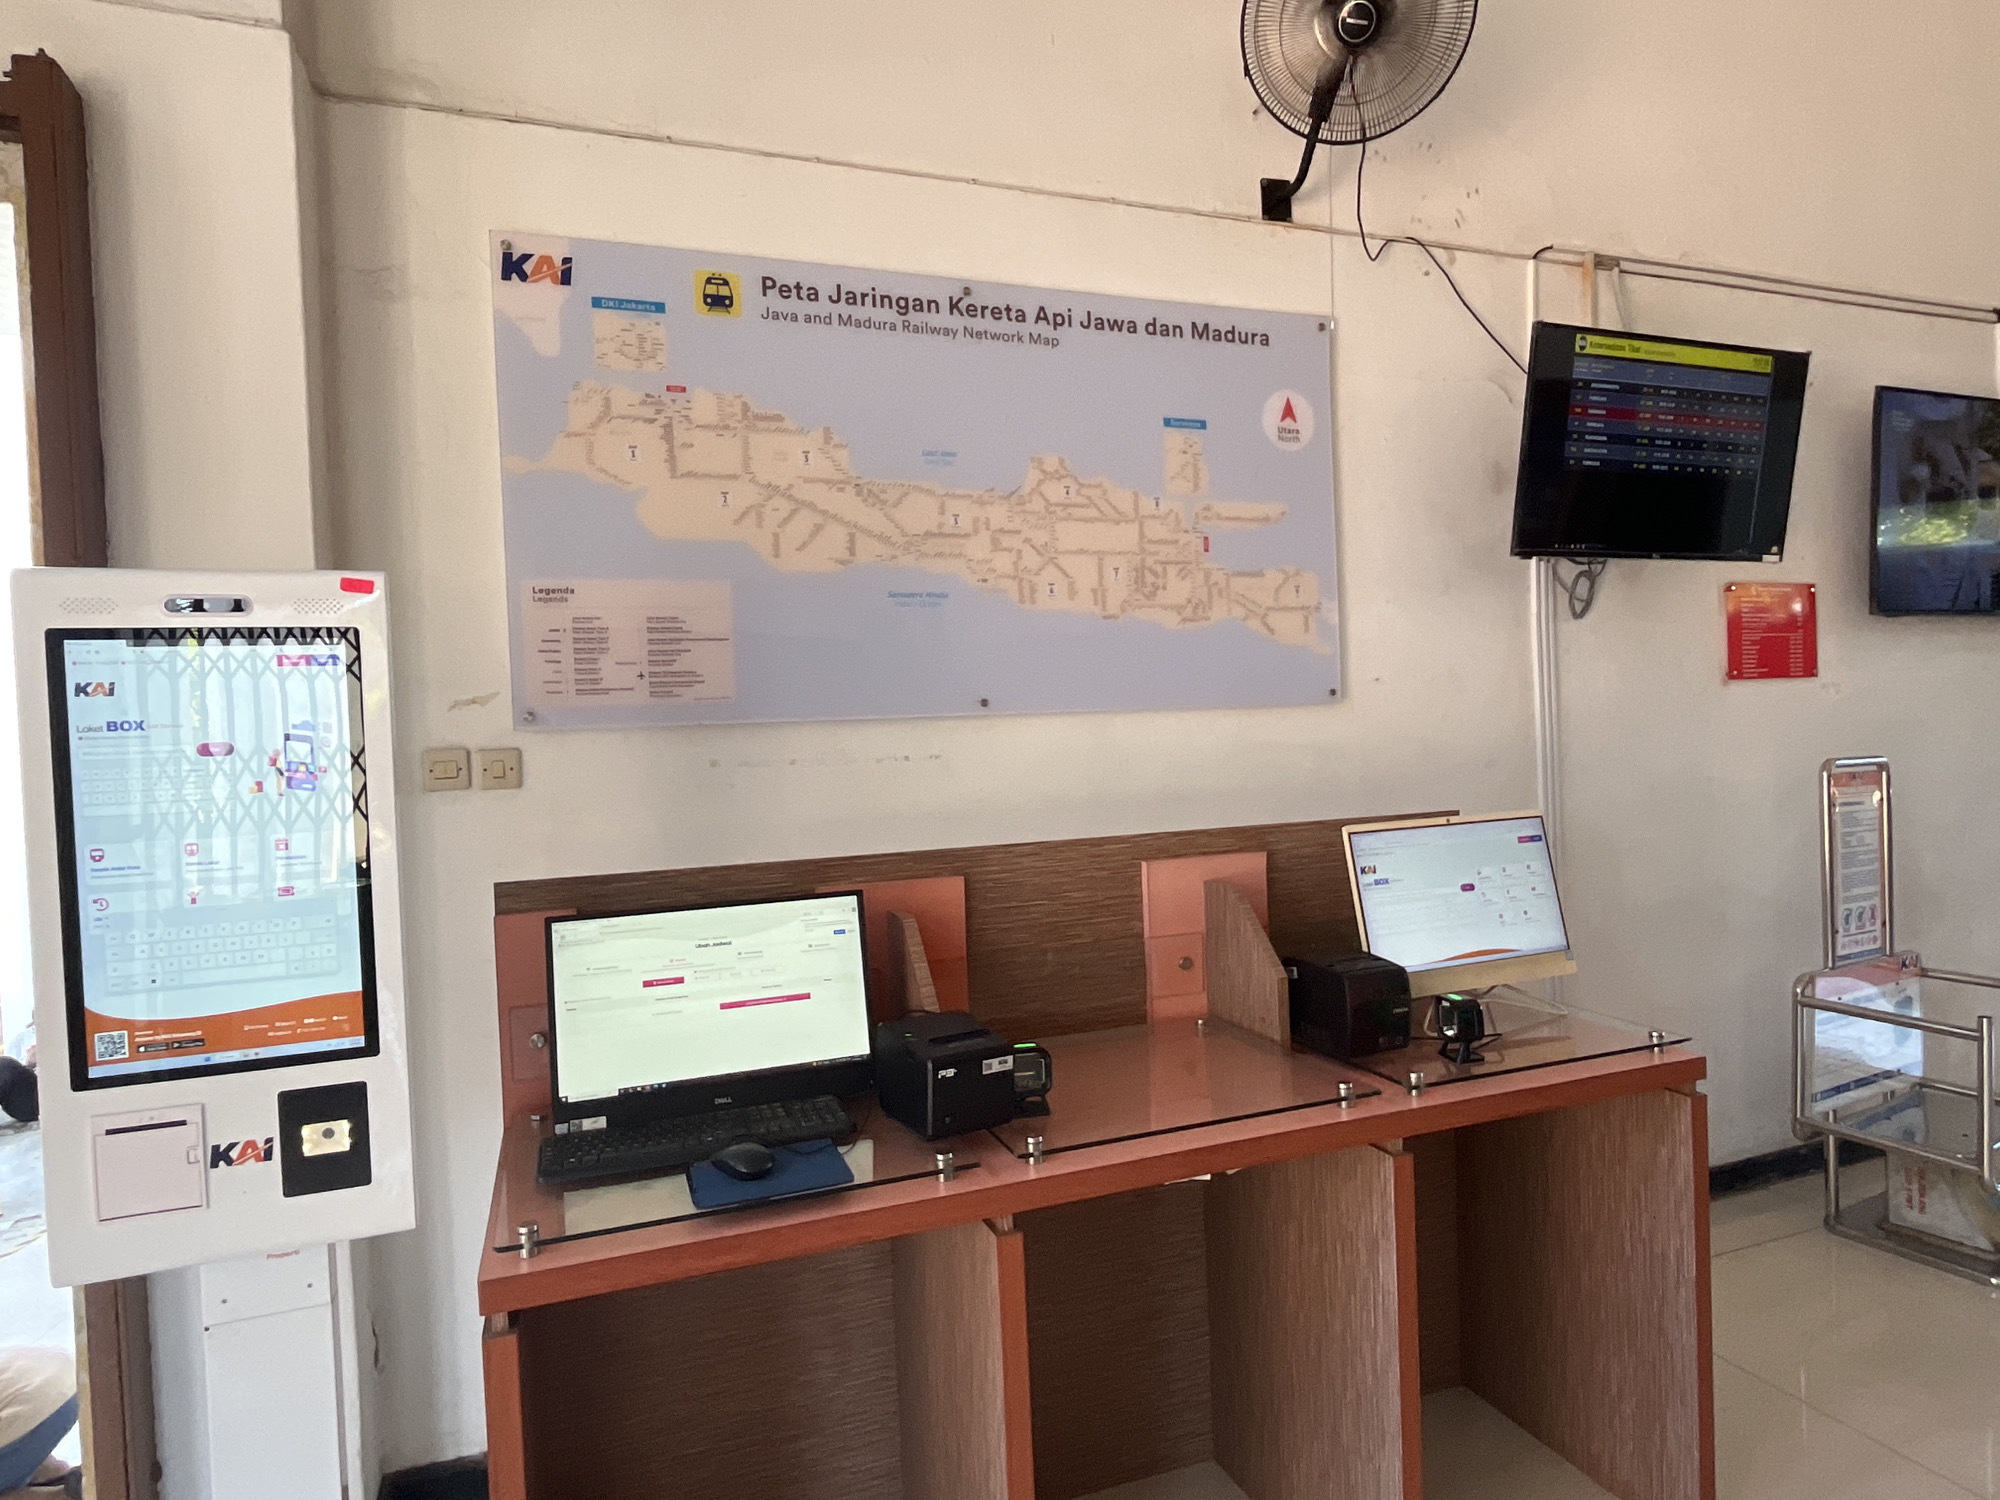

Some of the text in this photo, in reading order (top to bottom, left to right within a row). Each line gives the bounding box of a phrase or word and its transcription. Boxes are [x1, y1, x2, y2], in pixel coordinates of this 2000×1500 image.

[501, 252, 572, 286] KAI
[601, 299, 656, 311] DKI Jakarta
[761, 276, 1270, 346] Peta Jaringan Kereta Api Jawa dan Madura
[761, 306, 1059, 348] Java and Madura Railway Network Map
[1277, 426, 1300, 434] Utara
[1277, 434, 1300, 443] North
[532, 586, 575, 596] Legenda
[74, 681, 116, 698] KAI
[76, 724, 104, 733] Loket
[106, 720, 146, 732] BOX
[209, 1137, 274, 1169] KAI
